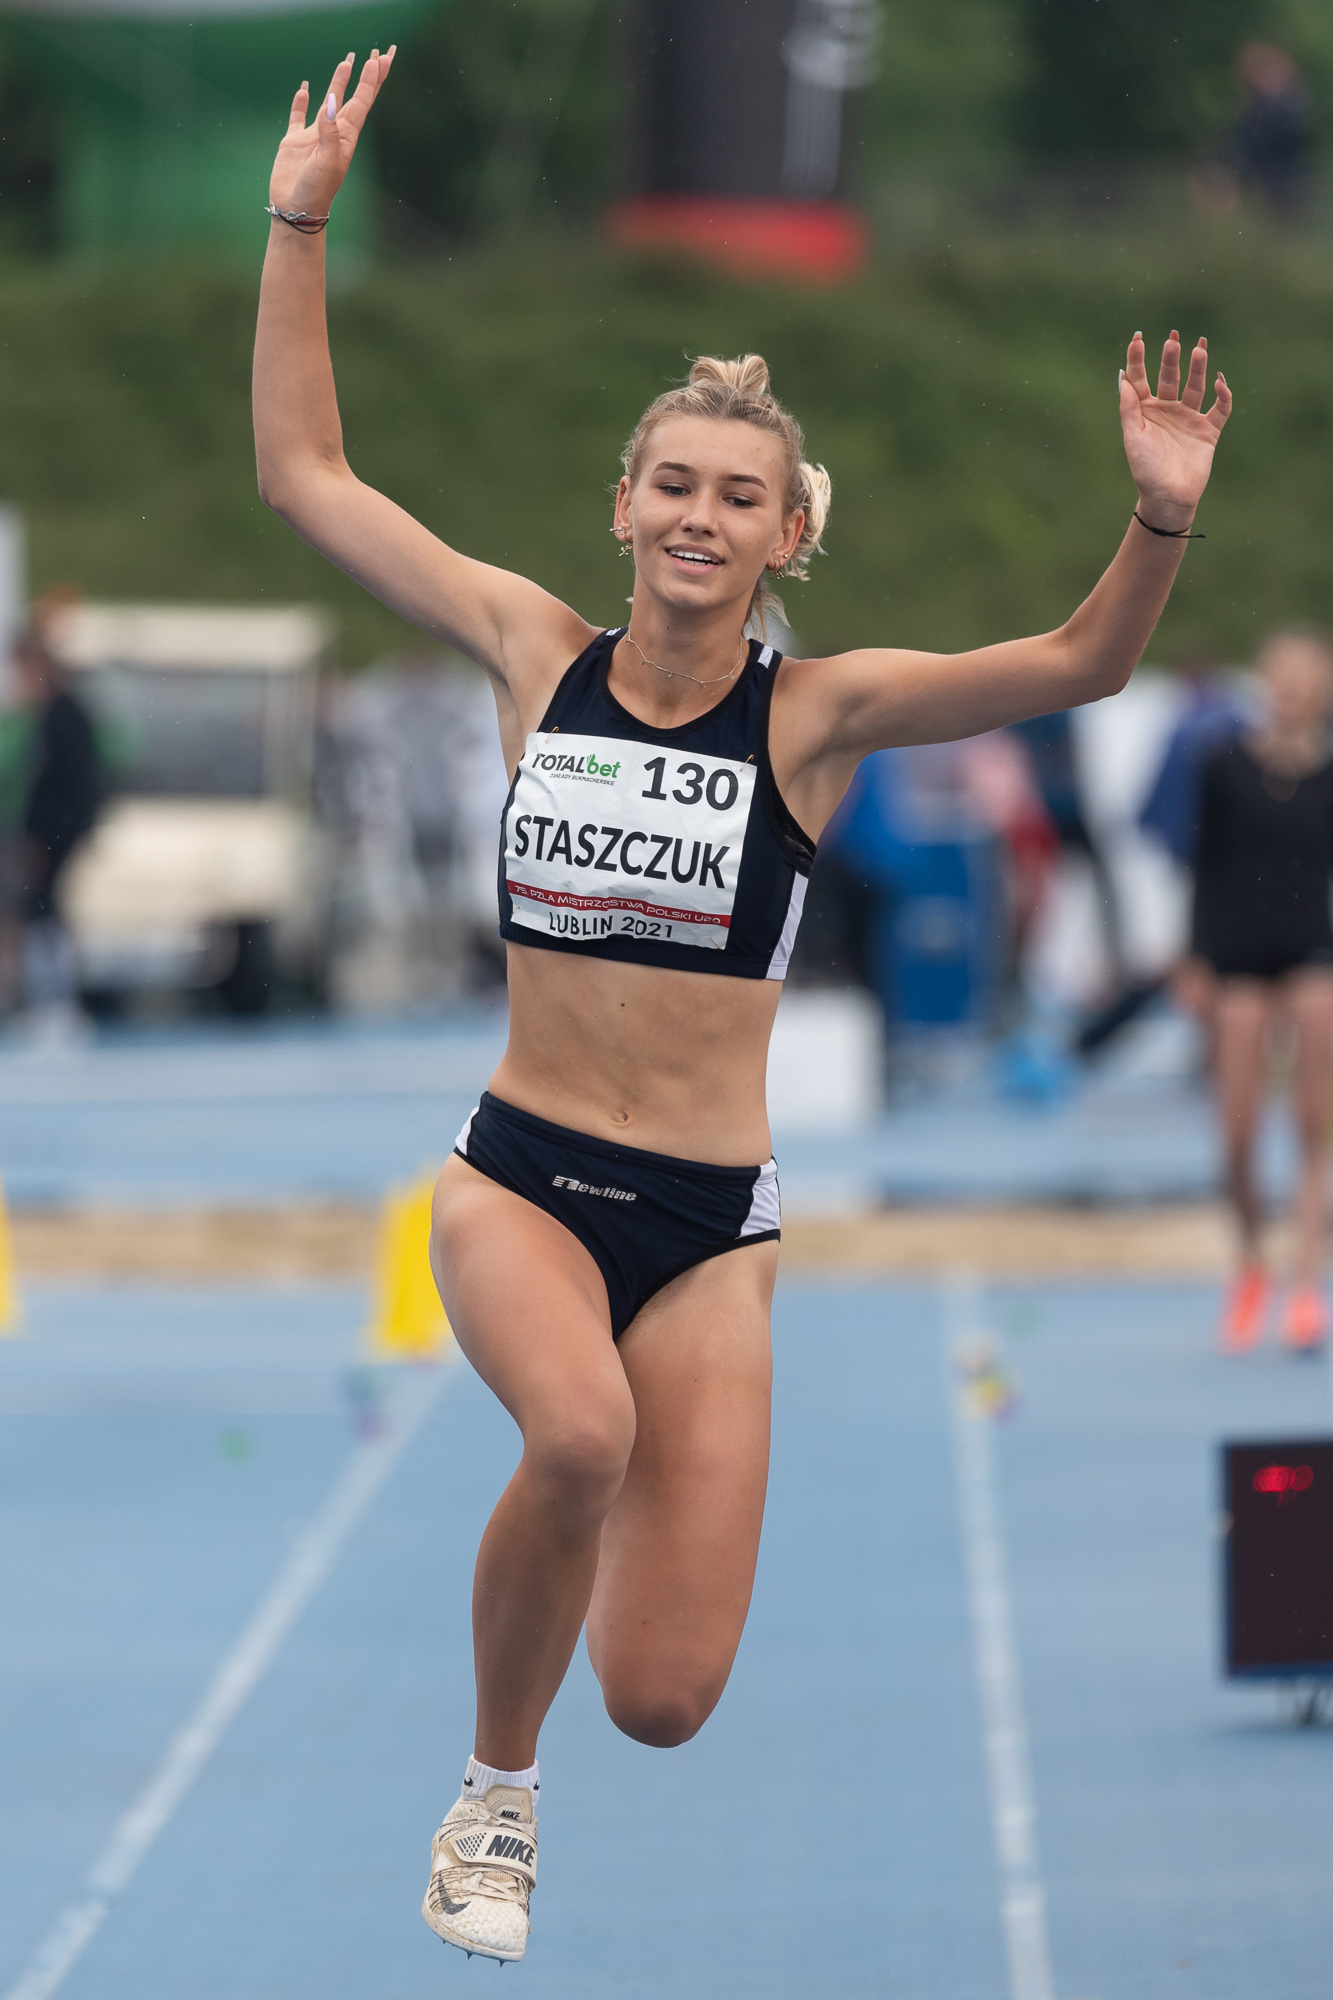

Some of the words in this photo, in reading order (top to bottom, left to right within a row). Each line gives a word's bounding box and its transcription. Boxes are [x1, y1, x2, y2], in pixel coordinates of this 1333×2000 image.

[532, 753, 621, 778] TOTALbet
[571, 775, 616, 787] BUKMACHERSKIE
[641, 757, 739, 811] 130
[514, 814, 731, 889] STASZCZUK
[515, 885, 529, 895] 75.
[530, 889, 556, 904] PZLA
[557, 895, 645, 911] MISTRZOSTWA
[646, 906, 692, 921] POLSKI
[694, 914, 721, 925] U20
[549, 911, 613, 936] LUBLIN
[620, 916, 673, 939] 2021
[500, 1809, 520, 1821] NIKE
[485, 1834, 536, 1868] NIKE
